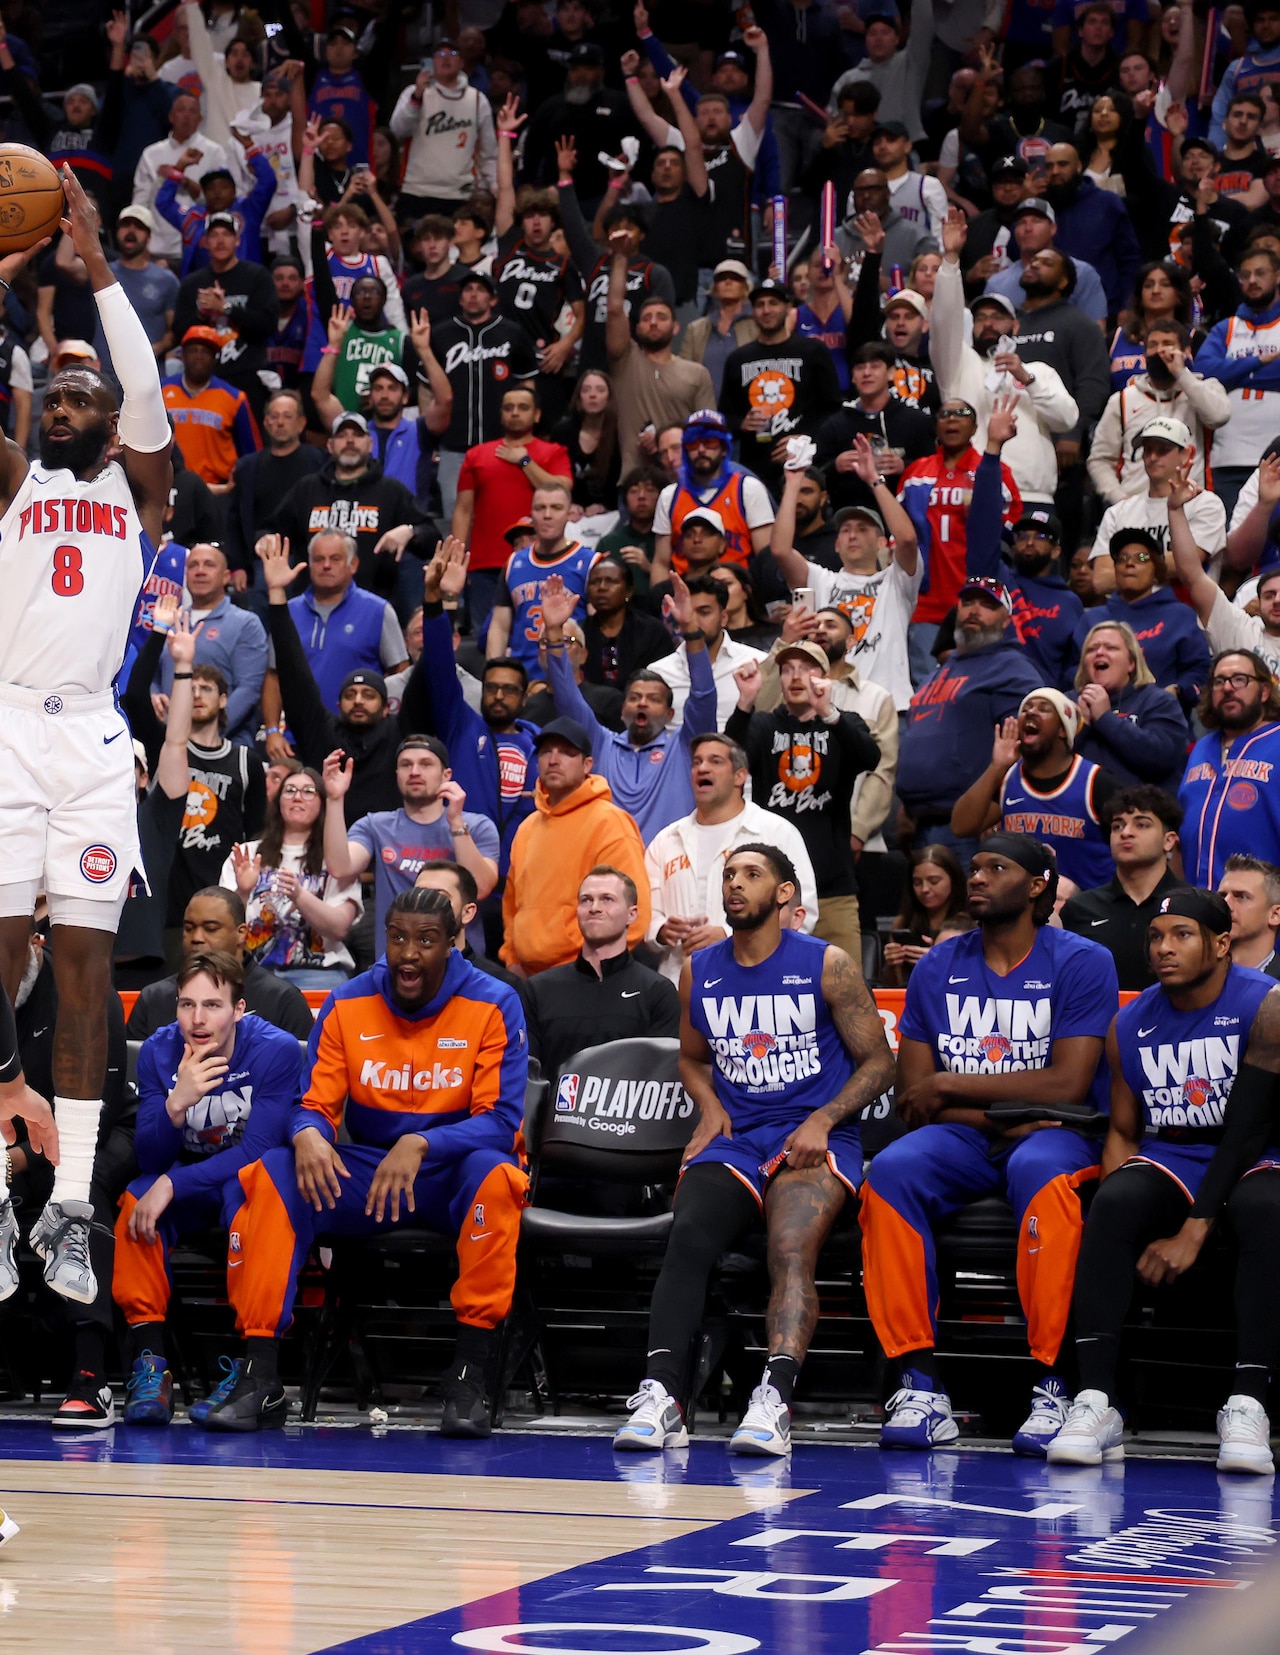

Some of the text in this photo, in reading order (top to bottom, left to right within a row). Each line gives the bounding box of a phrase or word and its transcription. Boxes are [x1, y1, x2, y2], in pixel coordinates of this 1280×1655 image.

[425, 111, 472, 136] Pistons
[499, 257, 559, 284] Detroit
[445, 340, 511, 374] Detroit
[741, 357, 804, 387] DETROIT
[19, 499, 128, 542] PISTONS
[52, 545, 84, 597] 8
[1223, 758, 1274, 784] YORK
[1003, 812, 1086, 839] NEW YORK
[86, 864, 110, 873] PISTONS
[87, 856, 111, 866] DETROIT
[702, 993, 816, 1038] WIN
[945, 992, 1051, 1041] WIN
[708, 1037, 746, 1058] FOR
[776, 1031, 818, 1050] THE
[938, 1033, 981, 1057] FOR
[1011, 1037, 1051, 1060] THE
[715, 1047, 821, 1086] BOROUGHS
[1138, 1034, 1240, 1088] WIN
[360, 1059, 464, 1091] Knicks
[578, 1076, 694, 1120] PLAYOFFS
[1142, 1086, 1184, 1107] FOR
[587, 1116, 636, 1136] Google
[859, 1584, 1189, 1655] ULTR
